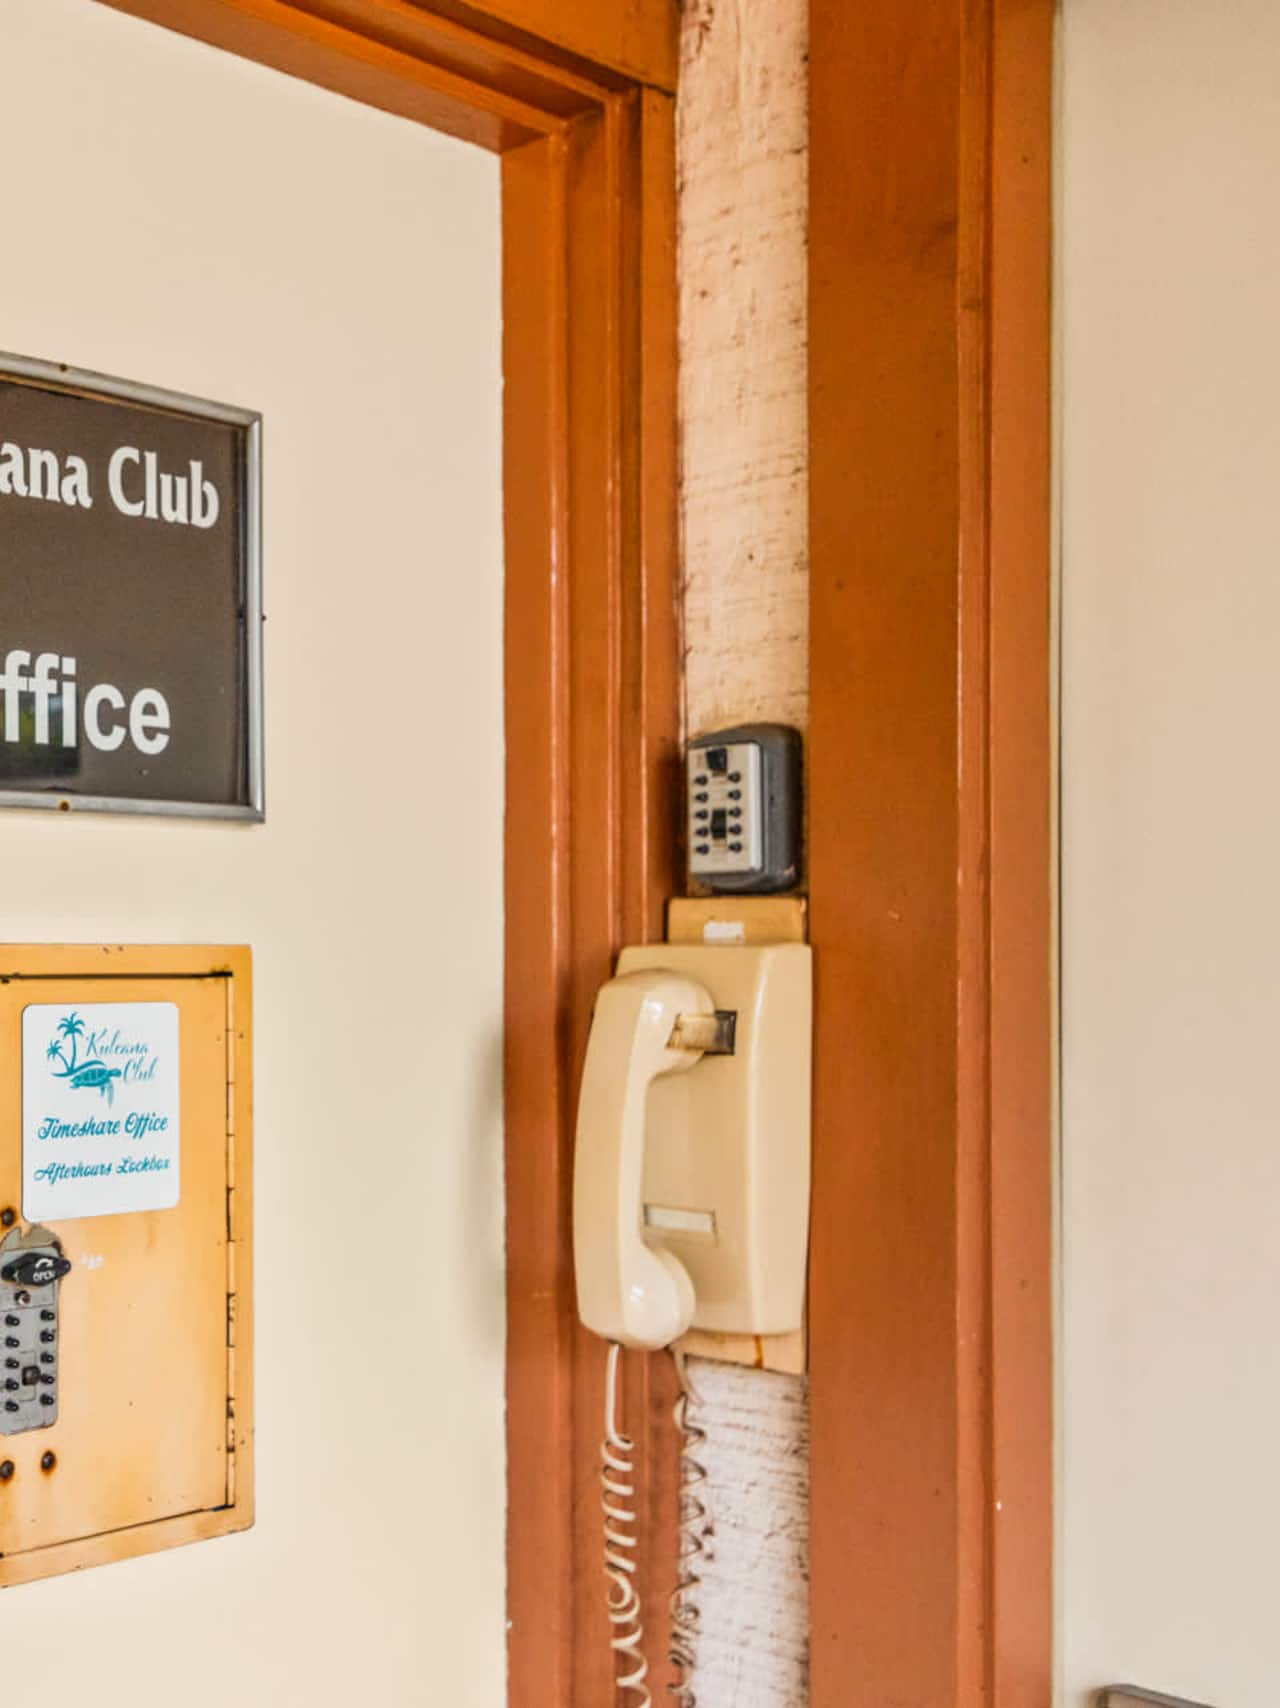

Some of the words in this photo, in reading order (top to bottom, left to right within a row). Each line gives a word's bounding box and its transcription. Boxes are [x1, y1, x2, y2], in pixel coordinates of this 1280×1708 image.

[108, 446, 219, 528] Club
[86, 1028, 148, 1057] Kuleana
[123, 1056, 159, 1083] Club
[38, 1116, 120, 1140] Timeshare
[125, 1112, 169, 1139] Office
[33, 1162, 113, 1185] Afterhours
[116, 1154, 170, 1174] Lockbox
